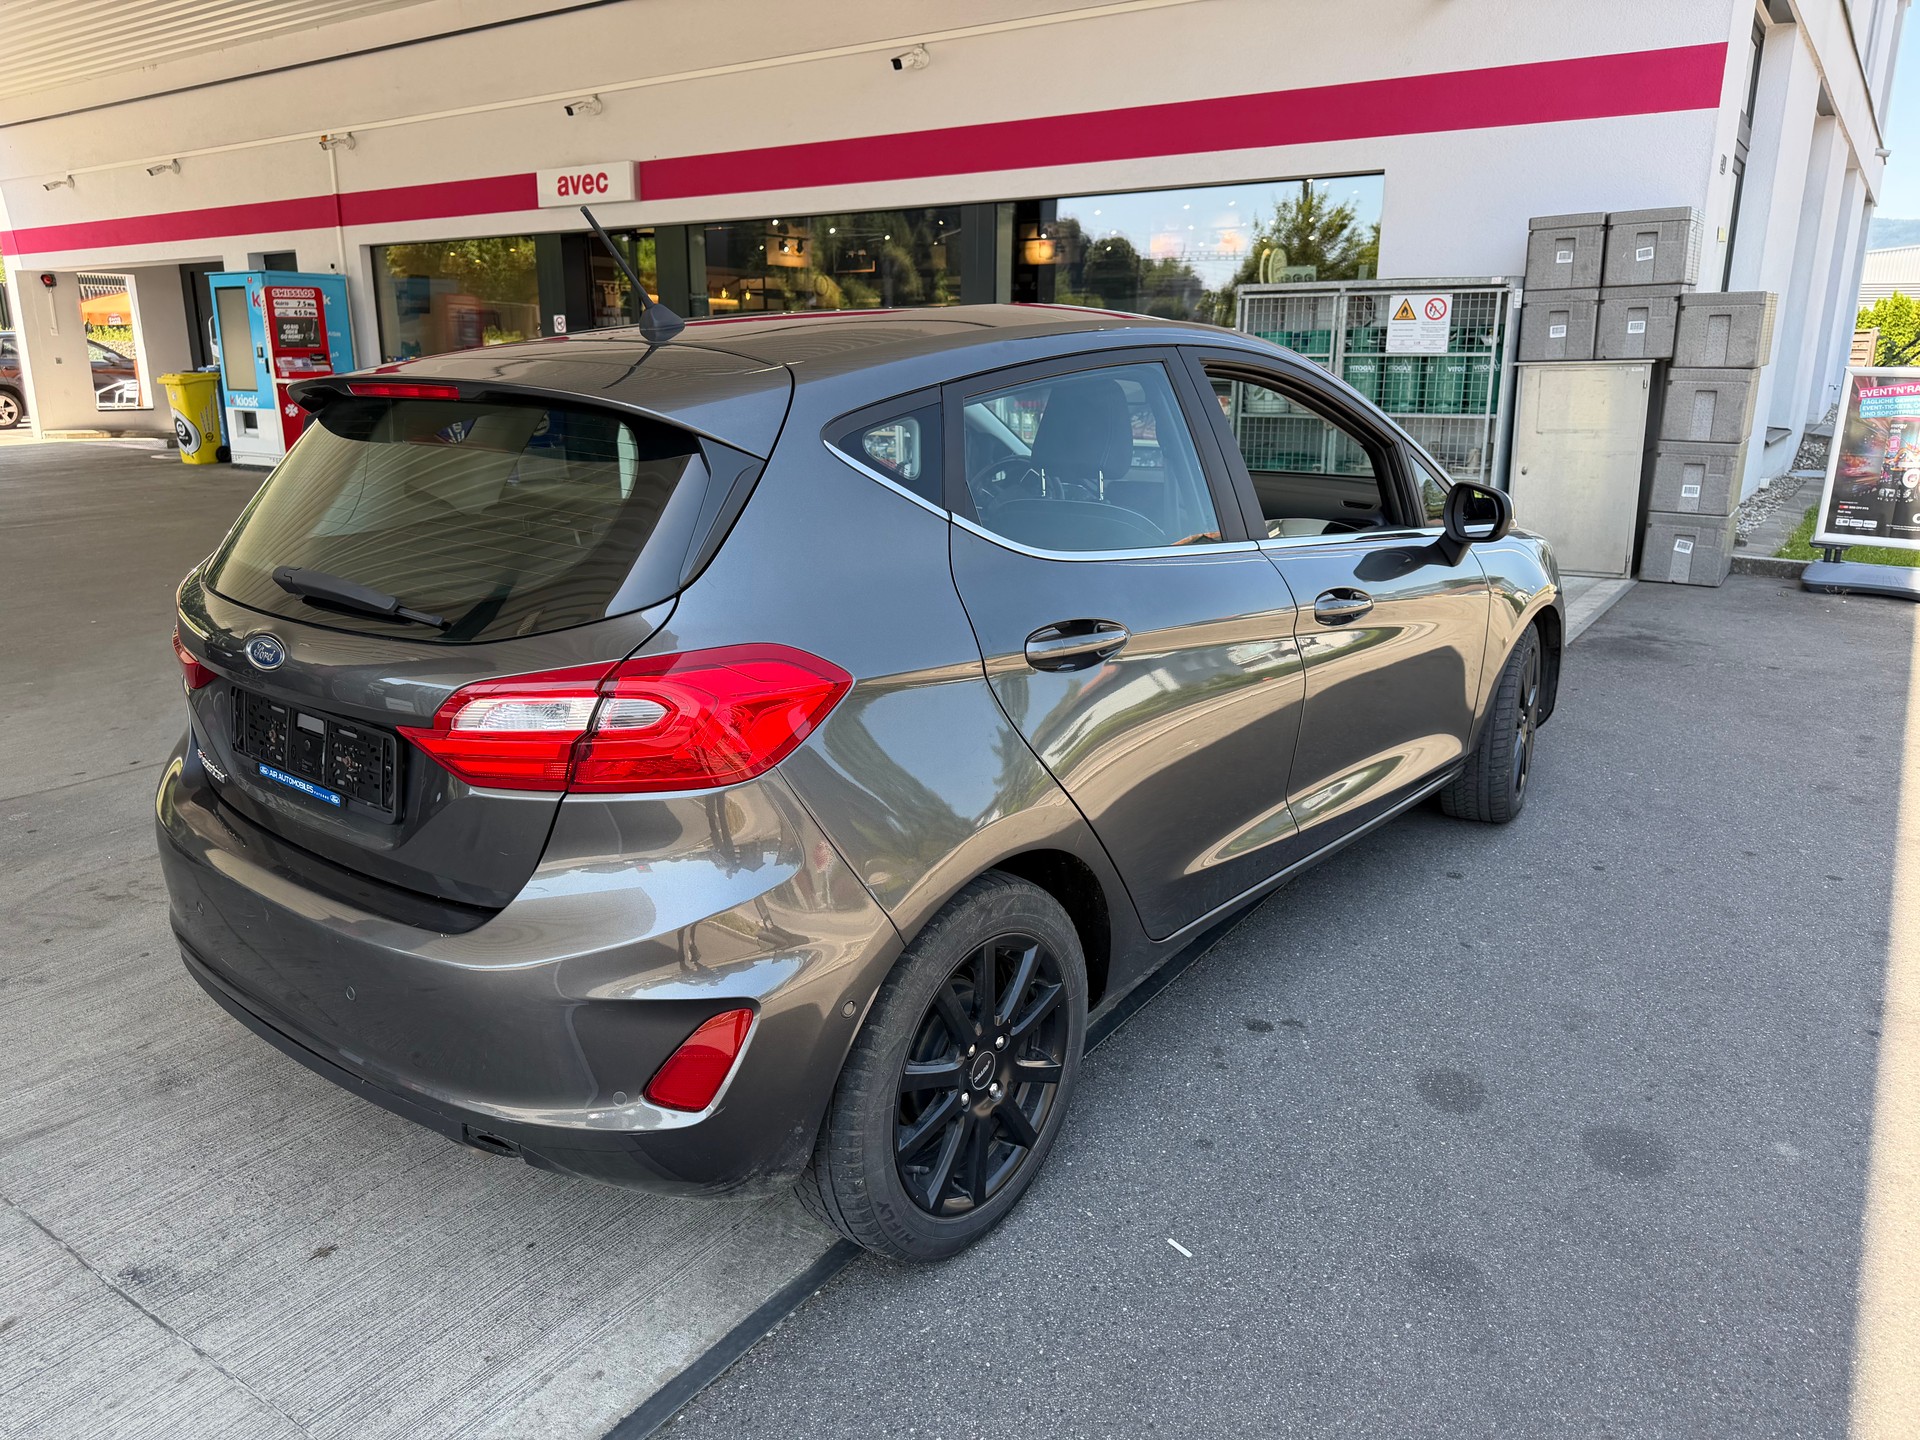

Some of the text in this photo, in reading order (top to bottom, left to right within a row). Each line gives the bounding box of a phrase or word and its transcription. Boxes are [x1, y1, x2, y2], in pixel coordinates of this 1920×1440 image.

[557, 172, 609, 197] avec
[272, 288, 316, 298] SWISSLOS
[235, 394, 259, 407] kiosk
[252, 641, 276, 662] Ford
[278, 773, 314, 794] AUTOMOBILES
